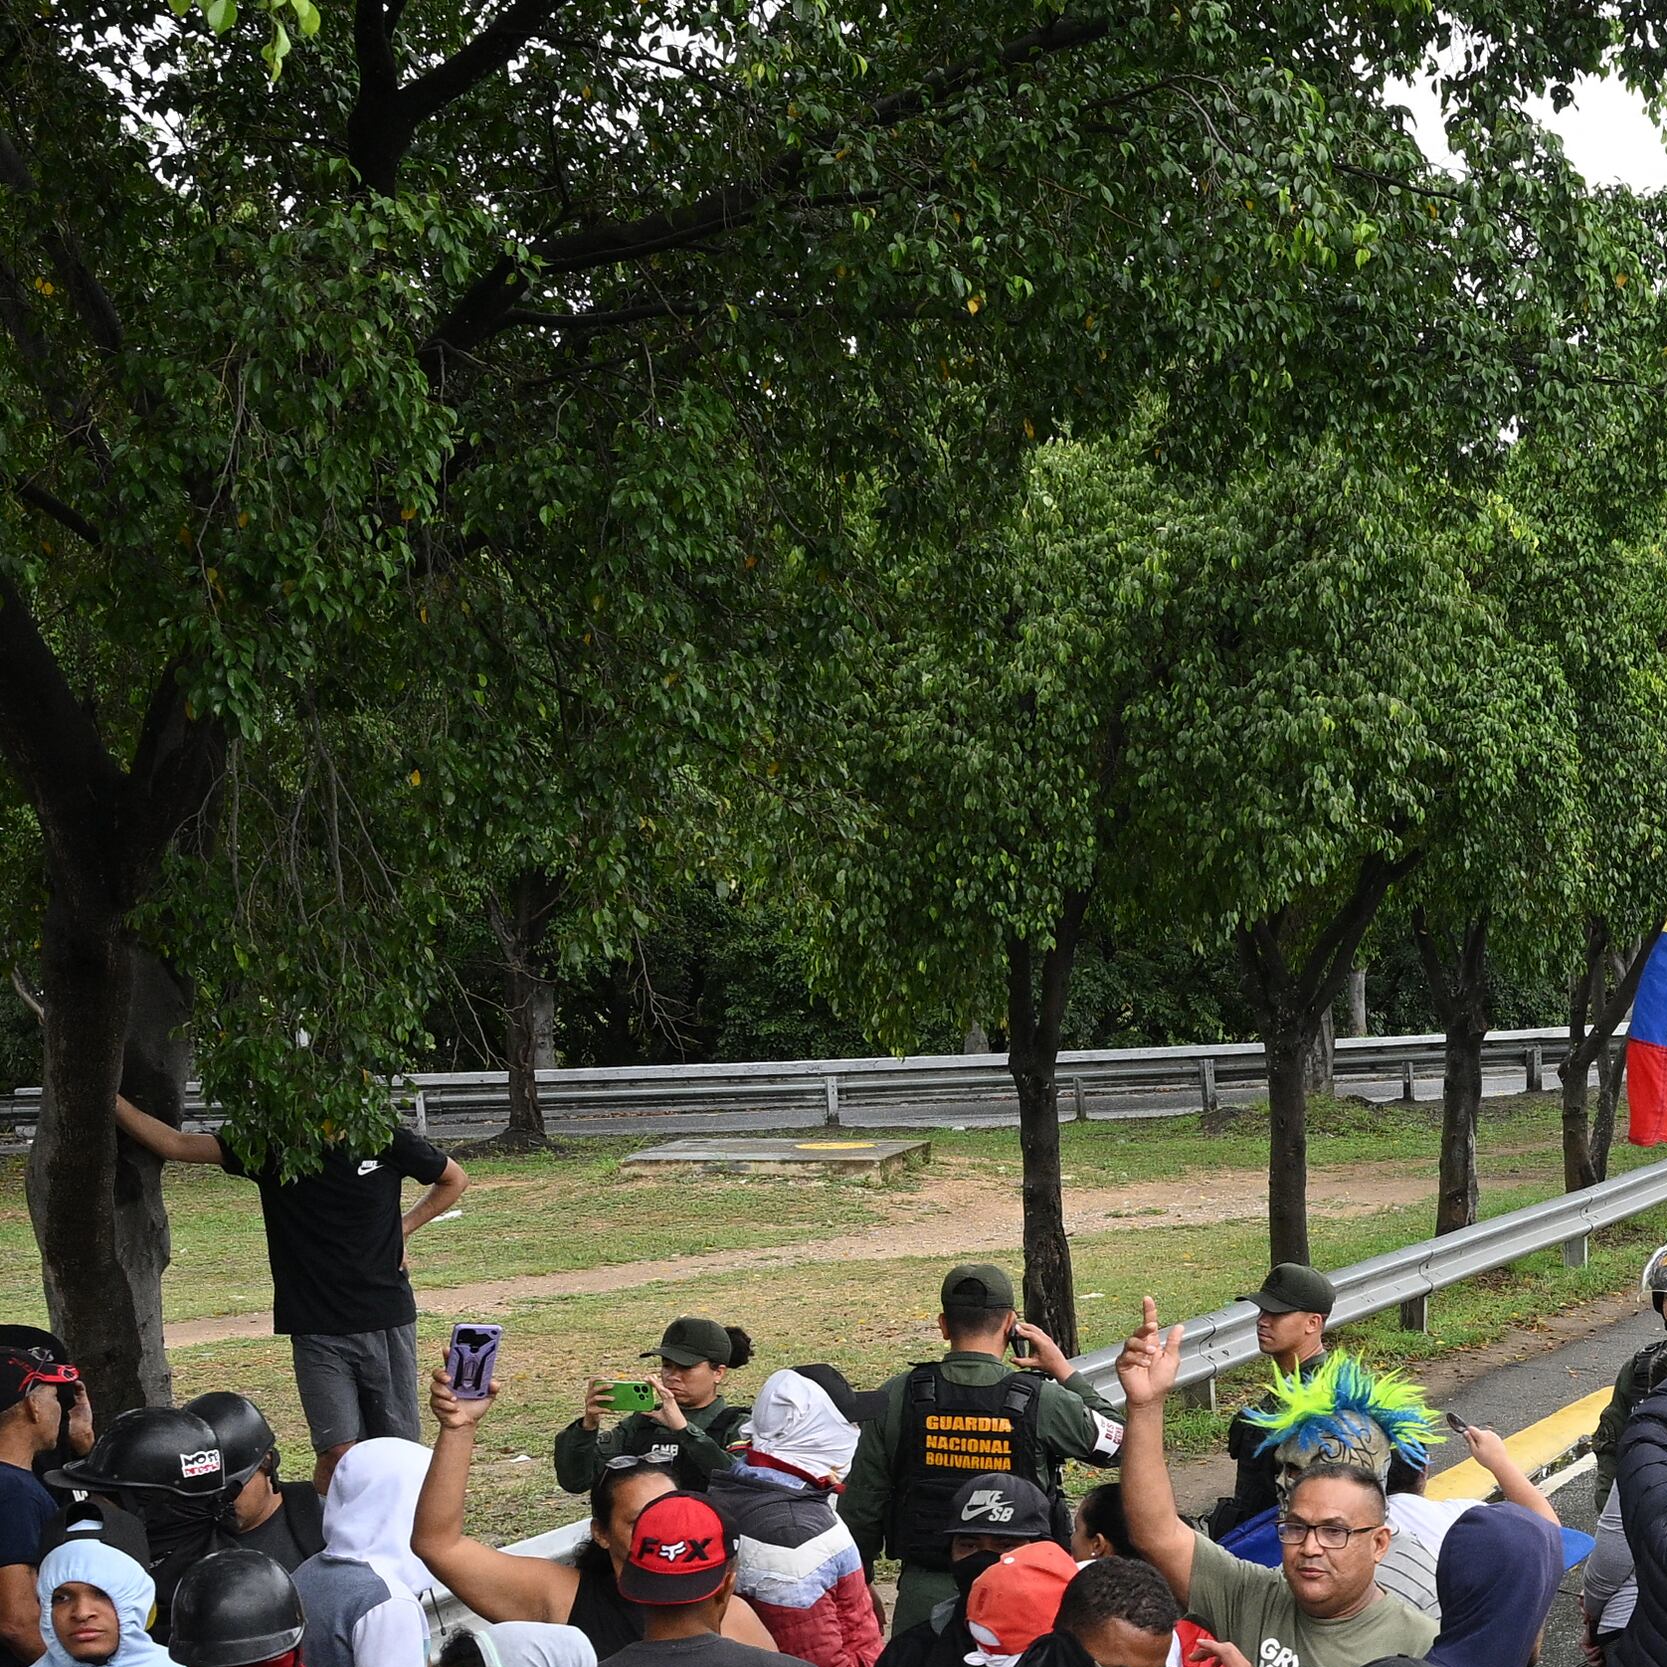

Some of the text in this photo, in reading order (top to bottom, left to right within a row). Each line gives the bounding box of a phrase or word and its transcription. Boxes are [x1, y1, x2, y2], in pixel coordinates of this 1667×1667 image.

[925, 1415, 1013, 1433] GUARDIA
[925, 1434, 1012, 1454] NACIONAL
[925, 1452, 1012, 1471] BOLIVARIANA
[988, 1506, 1015, 1523] SB
